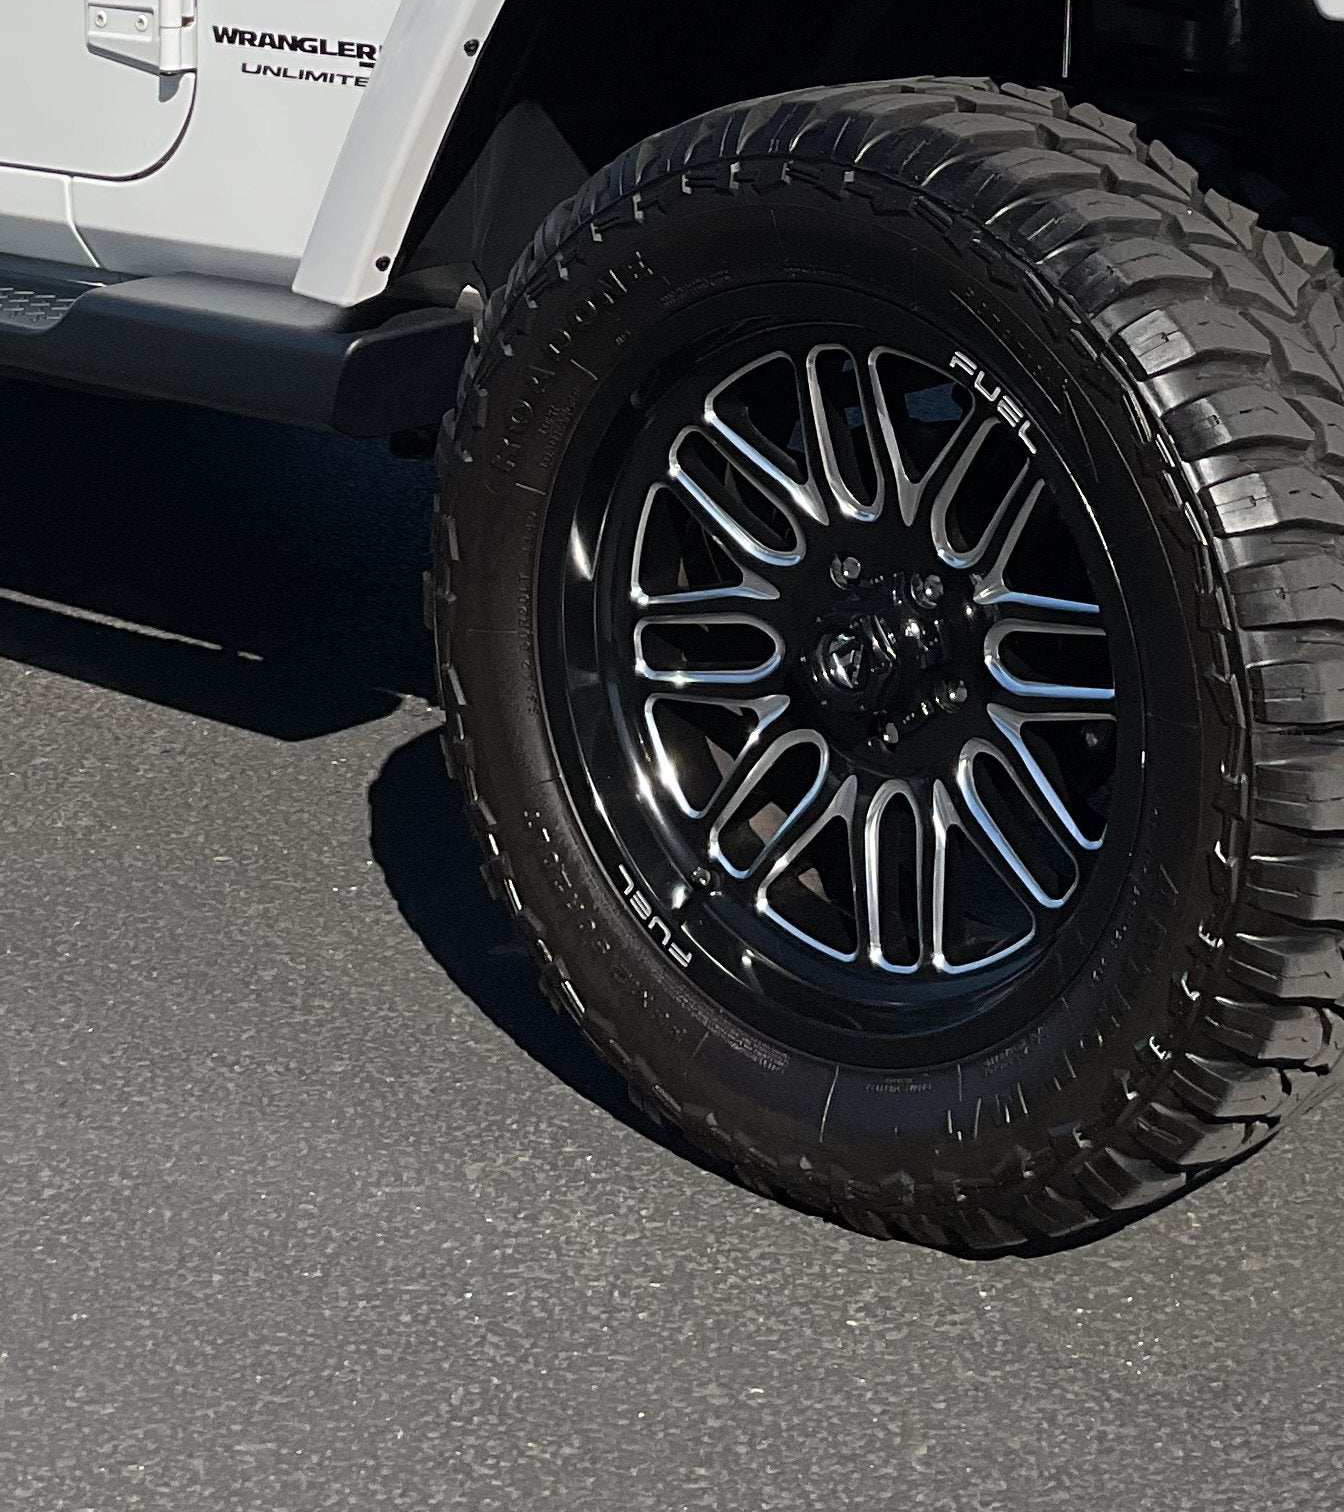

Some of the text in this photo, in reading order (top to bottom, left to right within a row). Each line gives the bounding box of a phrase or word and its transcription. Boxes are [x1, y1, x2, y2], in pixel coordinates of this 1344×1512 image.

[212, 25, 377, 61] WRANGLER
[949, 351, 1037, 455] FUEL
[618, 863, 693, 968] FUEL
